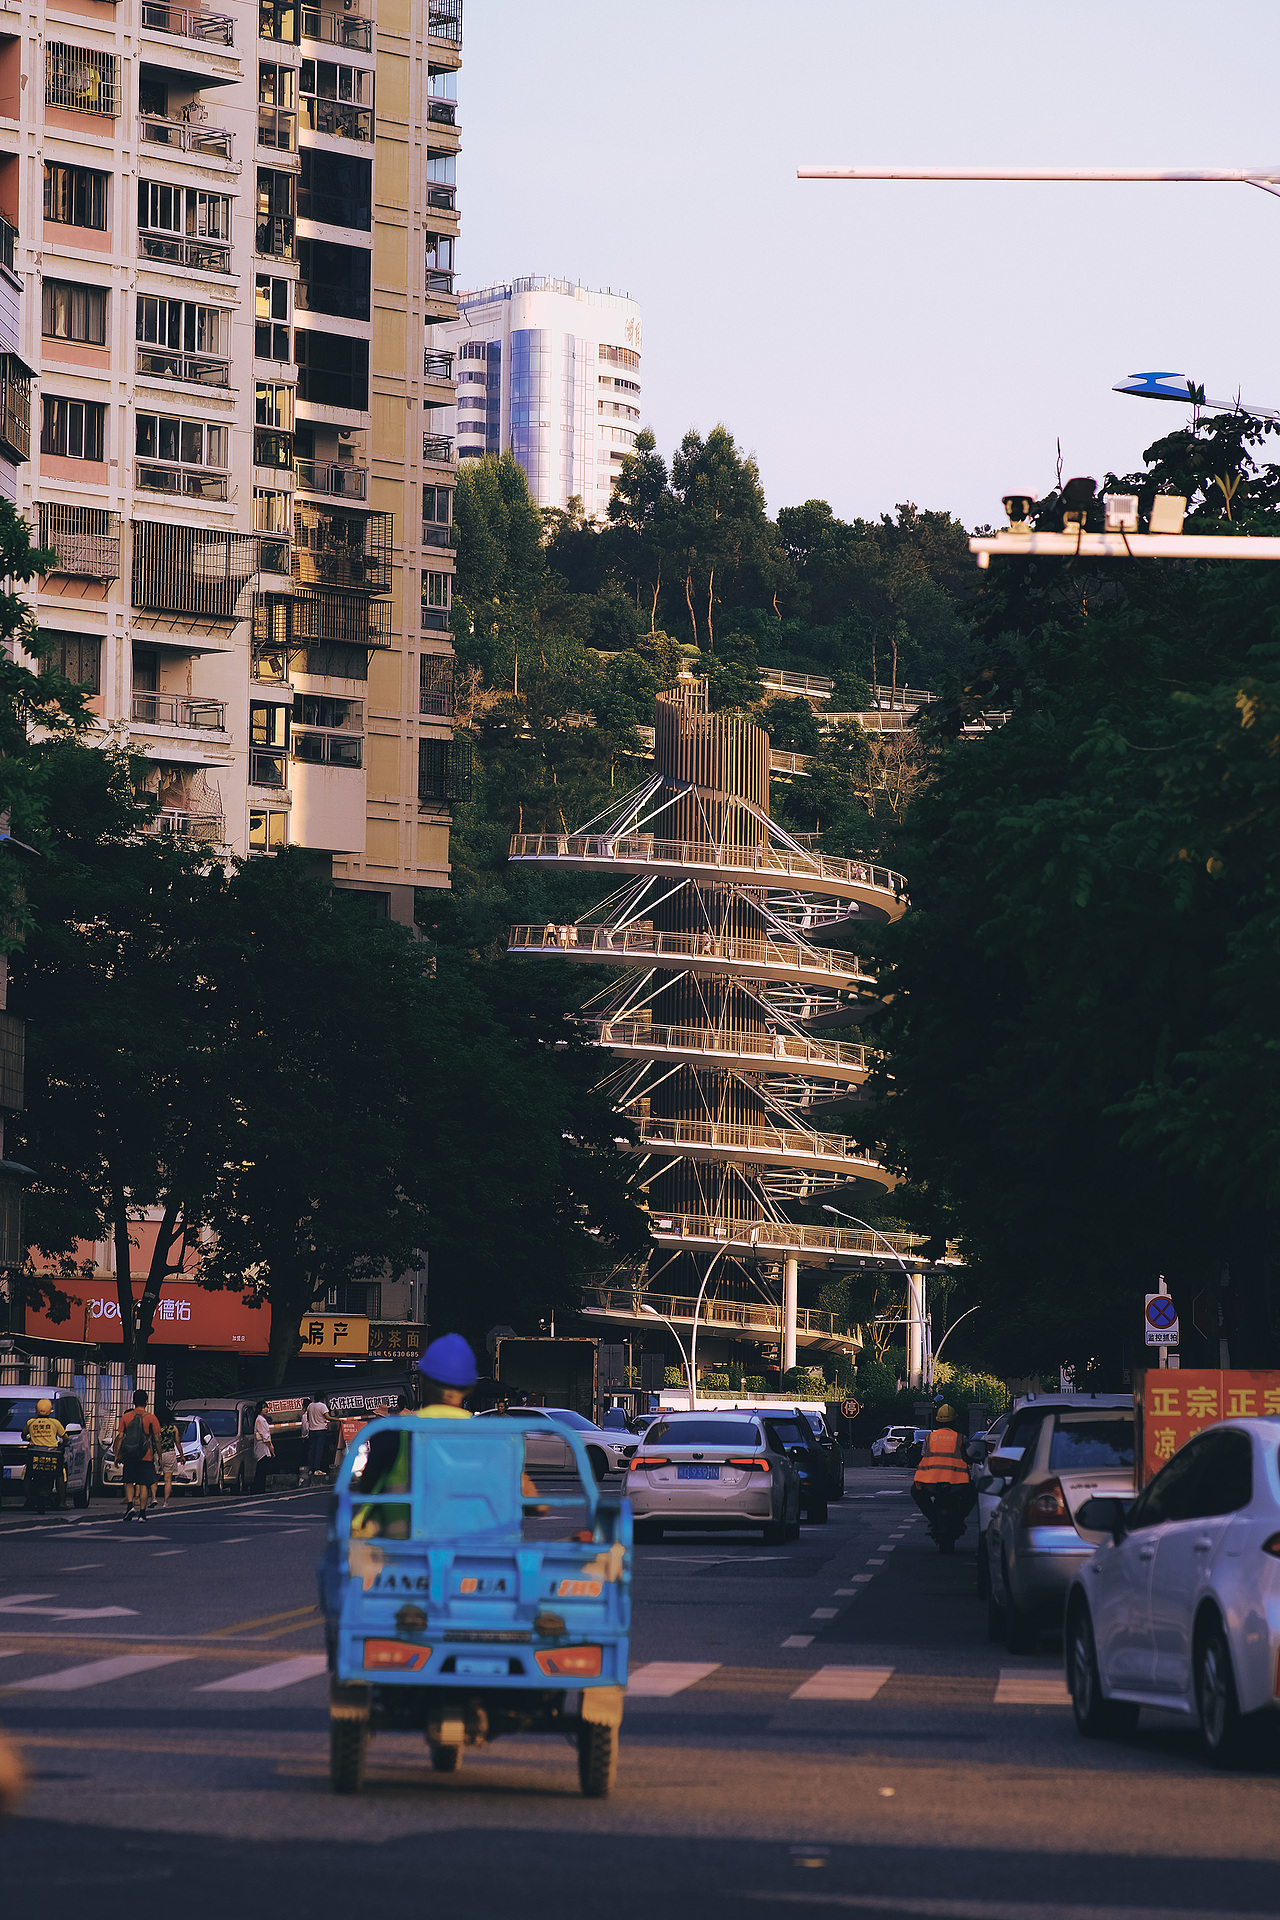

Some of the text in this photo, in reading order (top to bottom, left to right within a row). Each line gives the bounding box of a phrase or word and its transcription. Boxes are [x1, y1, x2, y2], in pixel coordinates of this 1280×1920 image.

[158, 1298, 191, 1321] 德佑
[309, 1321, 349, 1347] 房产
[370, 1329, 420, 1348] 沙茶面
[1148, 1333, 1178, 1342] 监控抓拍
[165, 1359, 174, 1396] SINCE
[330, 1395, 364, 1411] 大件托运
[844, 1401, 857, 1415] 停
[1149, 1386, 1218, 1419] 正宗
